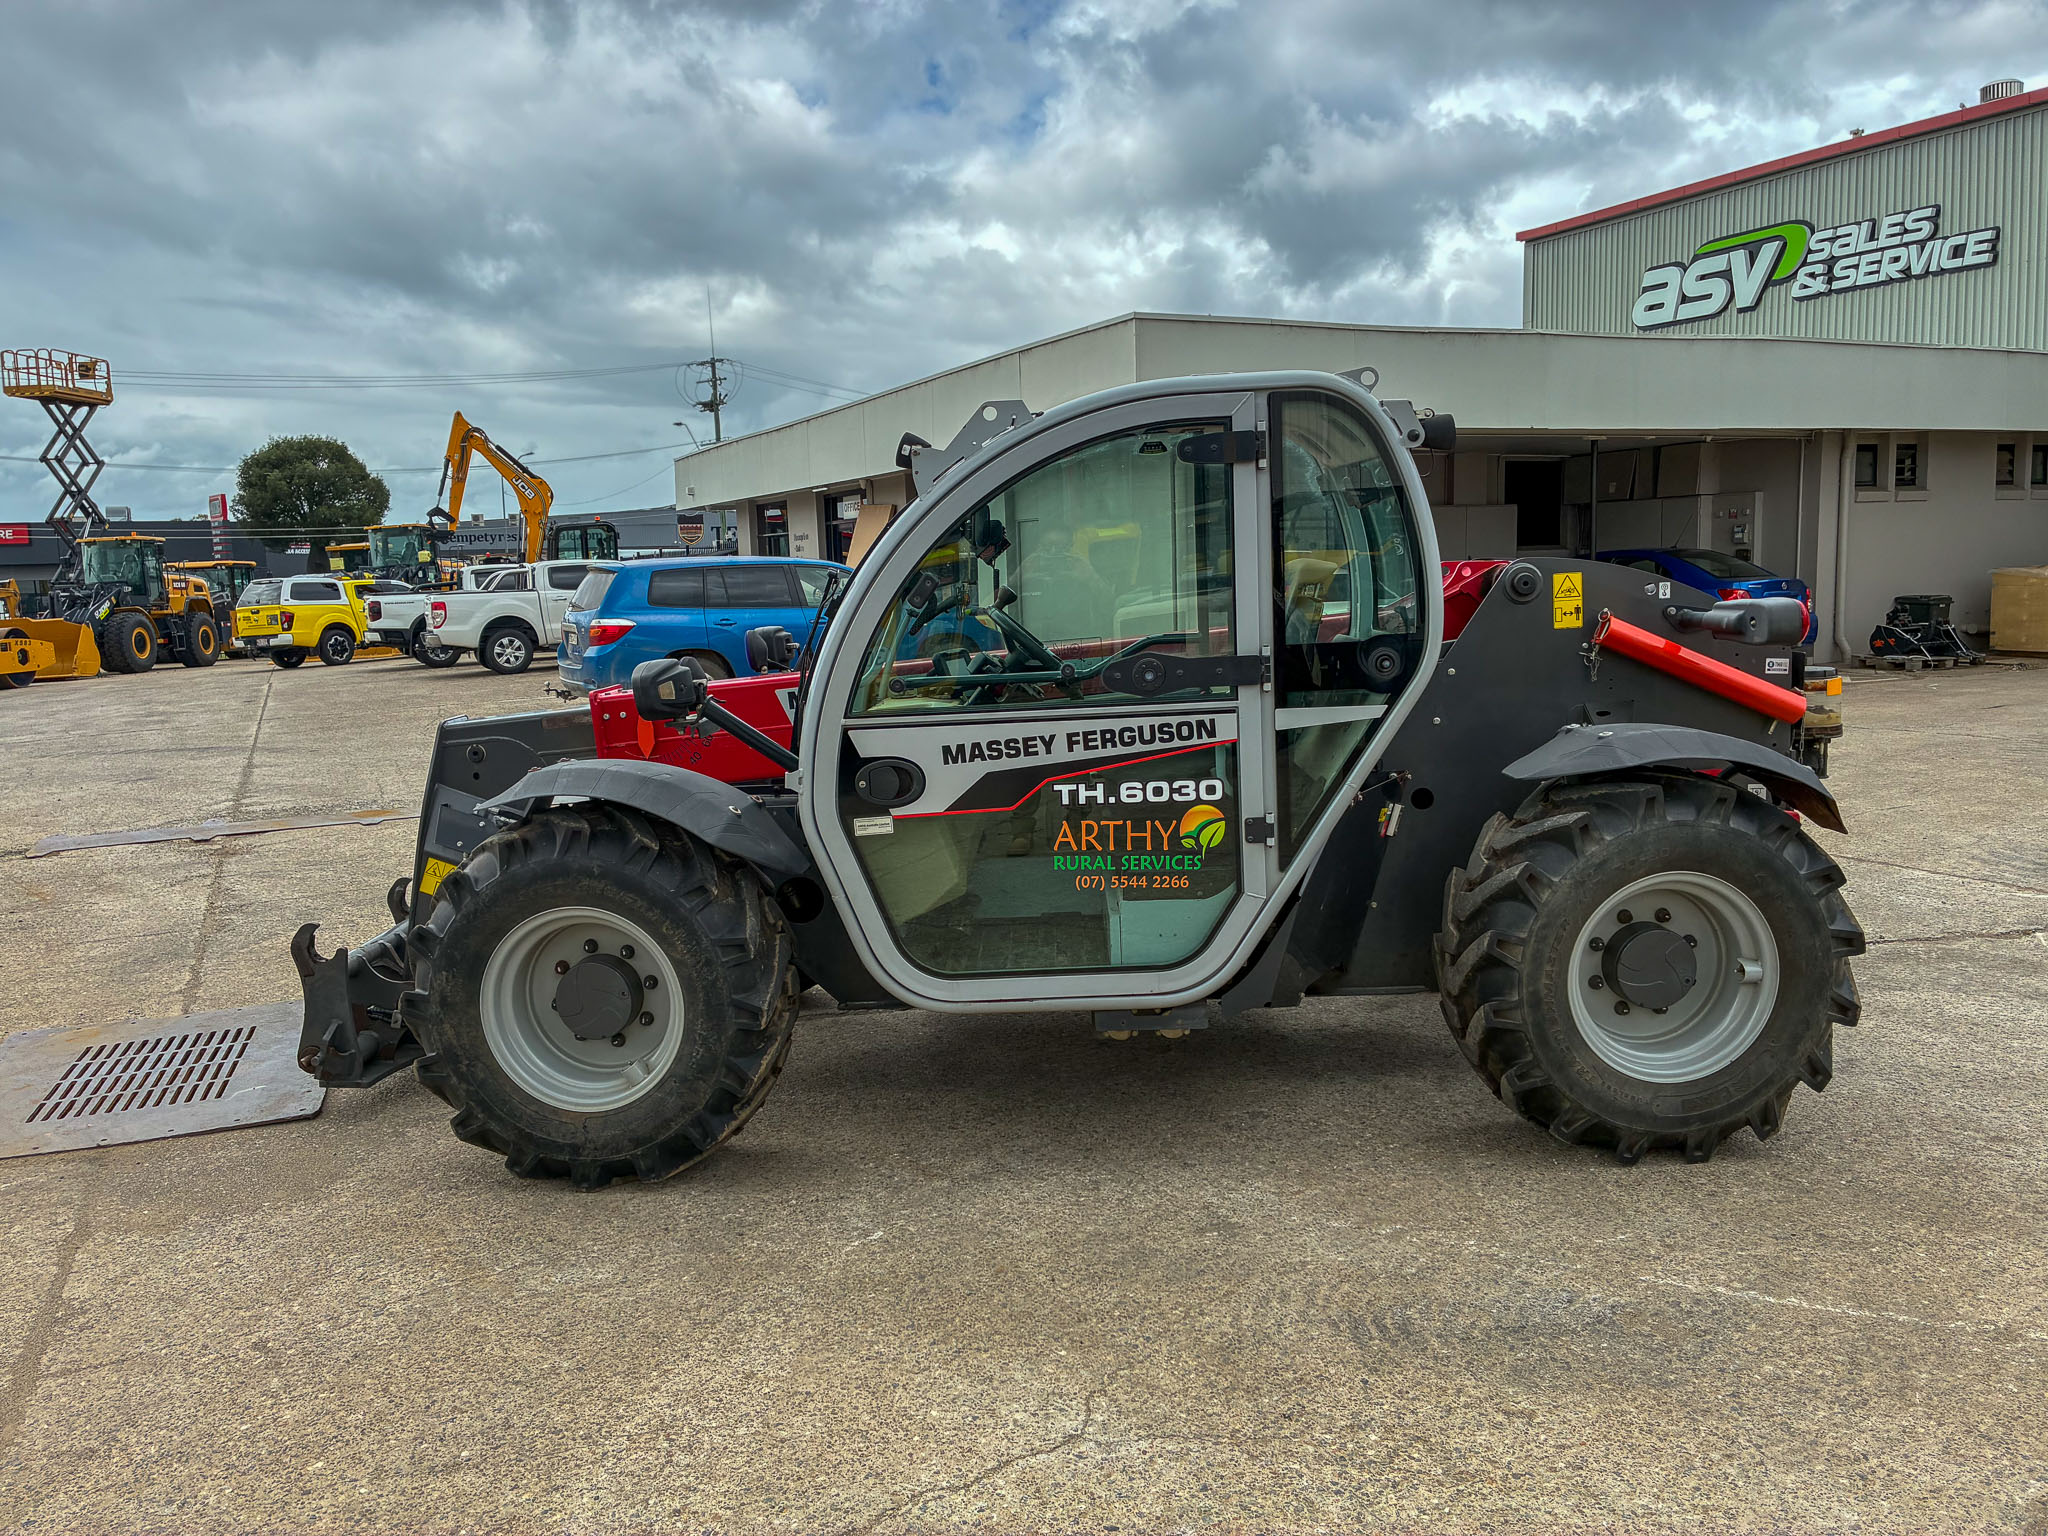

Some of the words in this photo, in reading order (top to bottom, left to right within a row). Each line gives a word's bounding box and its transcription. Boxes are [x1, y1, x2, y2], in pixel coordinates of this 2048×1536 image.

[1807, 206, 1939, 263] SALES
[1791, 263, 1832, 300] &
[1831, 228, 1997, 290] SERVICE
[512, 477, 536, 500] JCB
[844, 501, 860, 513] OFFICE
[702, 734, 714, 748] 60
[942, 734, 1057, 766] MASSEY
[1066, 718, 1217, 753] FERGUSON
[690, 751, 702, 765] 40
[1053, 779, 1223, 805] TH.6030
[1053, 820, 1177, 851] ARTHY
[1053, 855, 1116, 871] RURAL
[1121, 855, 1202, 871] SERVICES
[1075, 875, 1105, 891] (07)
[1110, 875, 1148, 889] 5544
[1152, 875, 1190, 889] 2266
